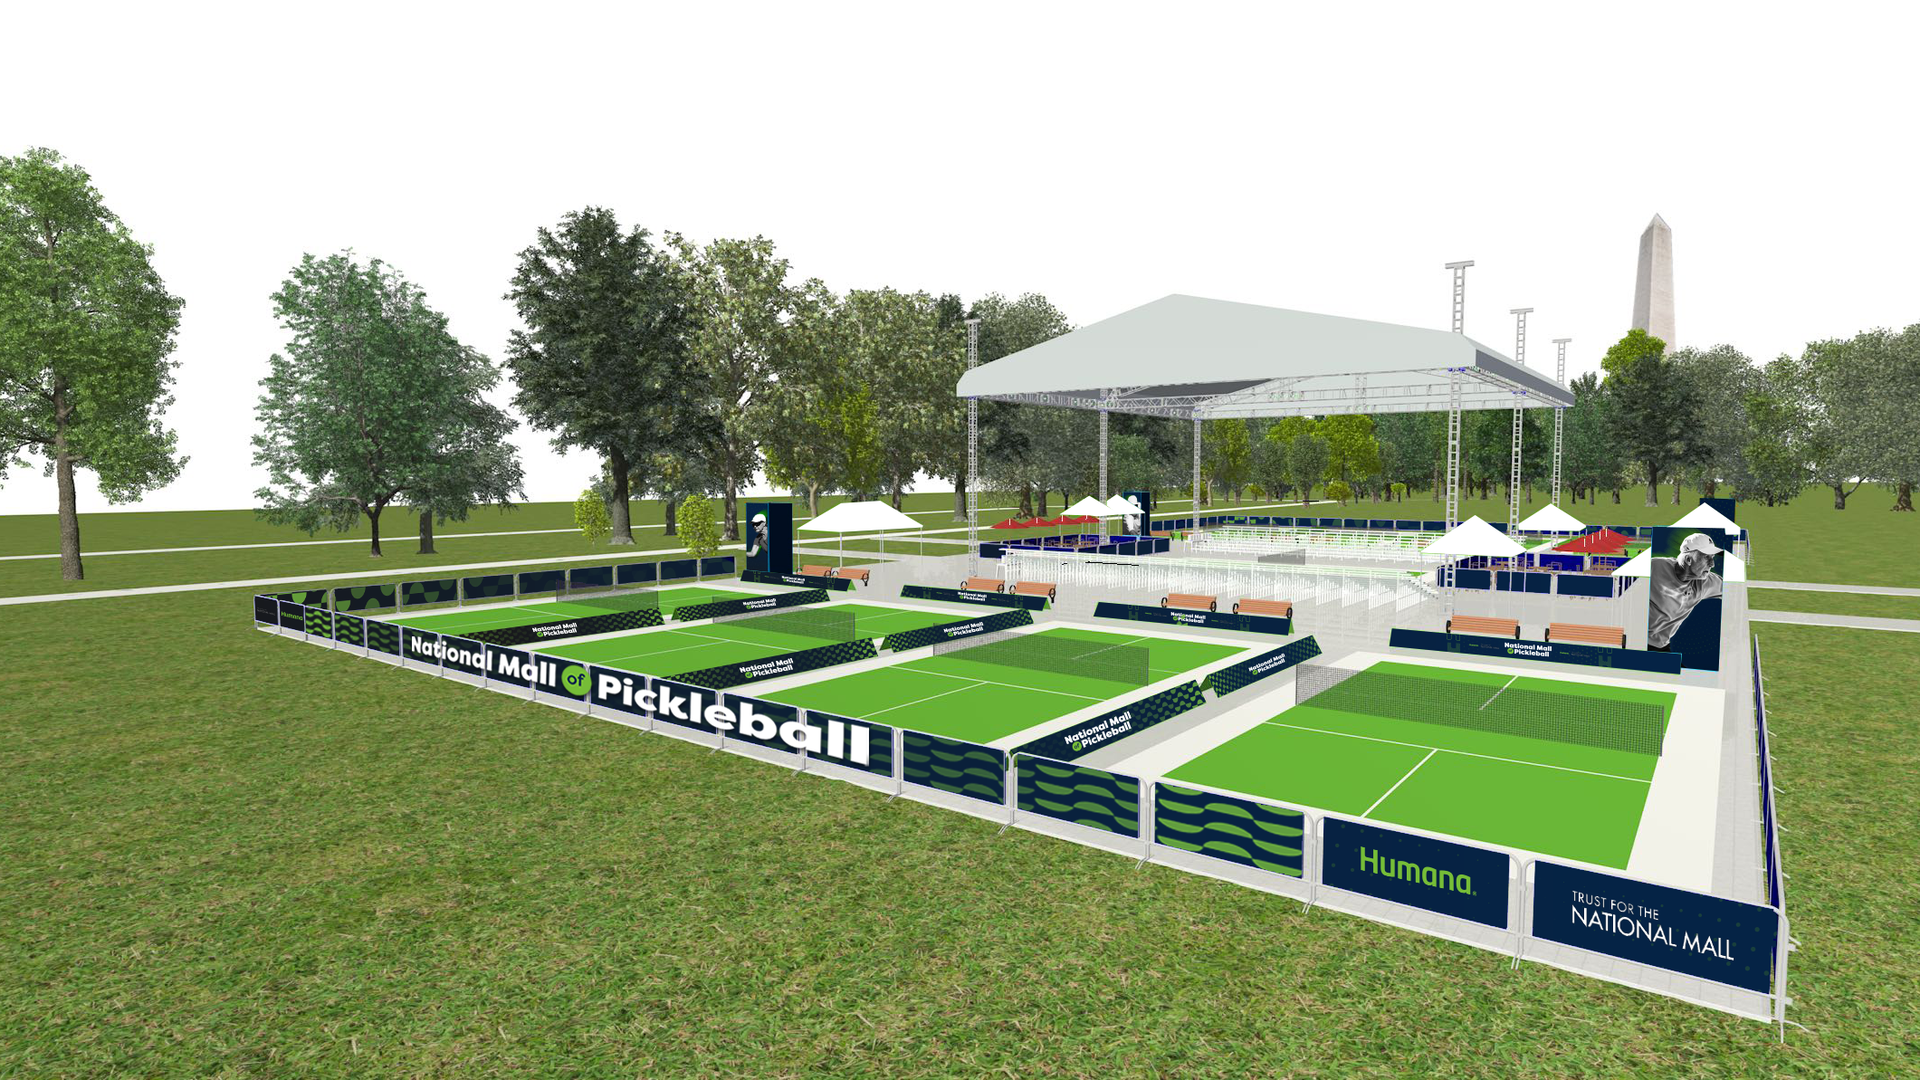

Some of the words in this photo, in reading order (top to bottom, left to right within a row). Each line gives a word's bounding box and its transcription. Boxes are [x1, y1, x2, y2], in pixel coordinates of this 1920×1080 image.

[1504, 642, 1535, 650] National
[1514, 649, 1549, 657] Pickleball
[739, 662, 775, 673] National
[776, 658, 793, 666] Mall
[752, 665, 793, 677] Pickleball
[411, 636, 492, 671] National
[498, 653, 557, 687] Mall
[598, 674, 870, 767] Pickleball
[1064, 720, 1109, 745] National
[1109, 711, 1132, 726] Mall
[1081, 721, 1132, 748] Pickleball
[1572, 890, 1607, 908] TRUST
[1610, 900, 1635, 915] FOR
[1638, 905, 1659, 921] THE
[1572, 905, 1677, 947] NATIONAL
[1682, 931, 1735, 961] MALL
